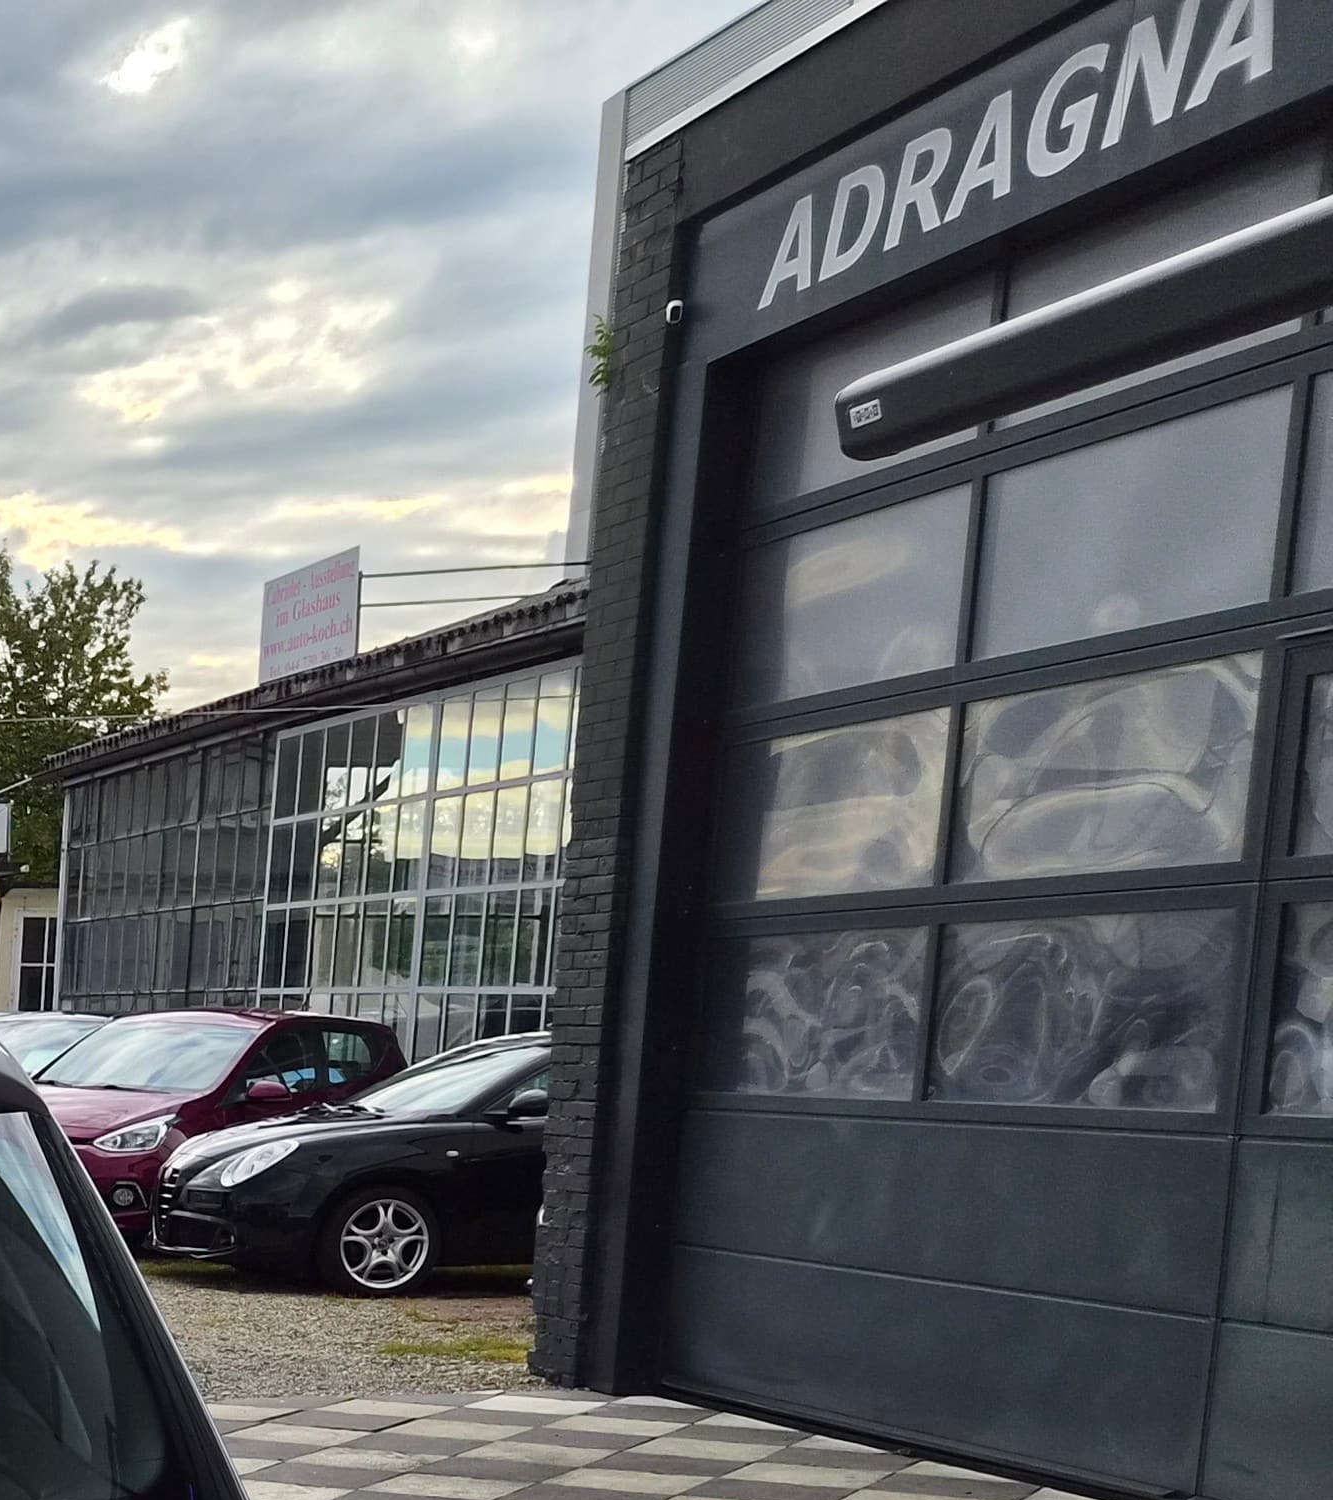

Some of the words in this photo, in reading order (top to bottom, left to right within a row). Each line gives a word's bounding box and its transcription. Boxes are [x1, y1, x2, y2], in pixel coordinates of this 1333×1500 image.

[757, 0, 1276, 311] ADRAGNA
[276, 608, 289, 628] im
[293, 590, 341, 621] Glashaus
[263, 612, 353, 657] www.auto-koch.ch
